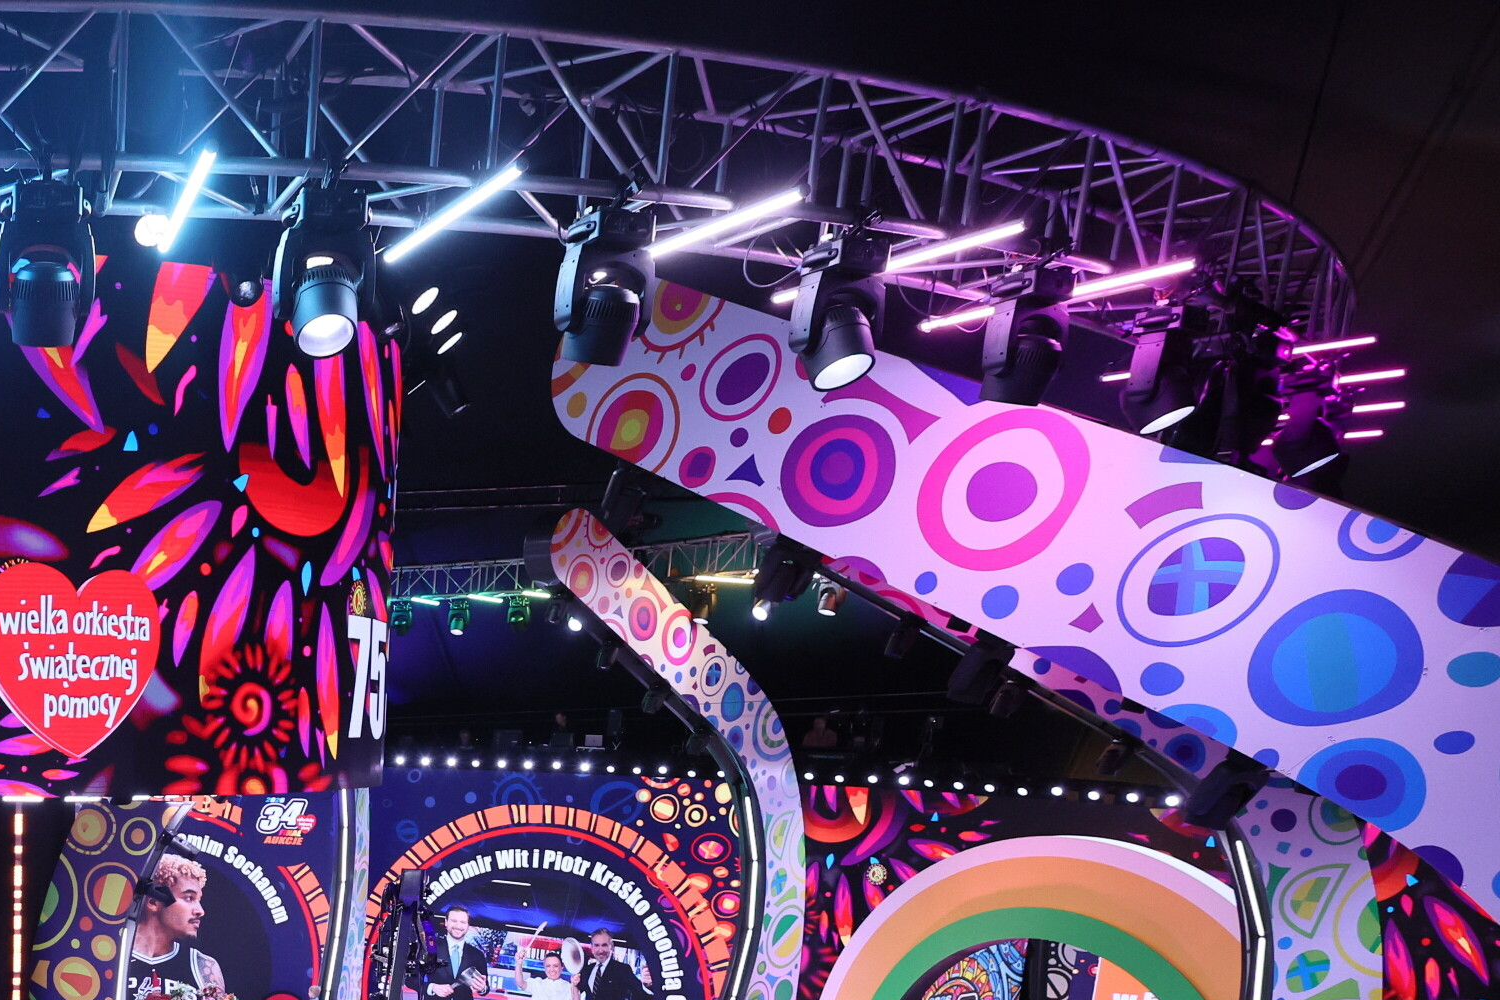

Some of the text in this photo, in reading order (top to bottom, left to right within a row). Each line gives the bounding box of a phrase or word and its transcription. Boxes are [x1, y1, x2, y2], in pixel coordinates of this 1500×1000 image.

[72, 600, 151, 641] orkiestra
[17, 641, 138, 695] świątecznej
[347, 613, 388, 741] 75
[43, 692, 122, 728] pomocy
[257, 799, 307, 833] 34
[263, 836, 304, 846] AUKCJE
[224, 846, 289, 925] Sochanem
[495, 848, 529, 870] Wit
[532, 849, 539, 862] i
[542, 850, 592, 876] Piotr
[590, 861, 651, 916] Kraśko
[642, 912, 684, 991] ugotują
